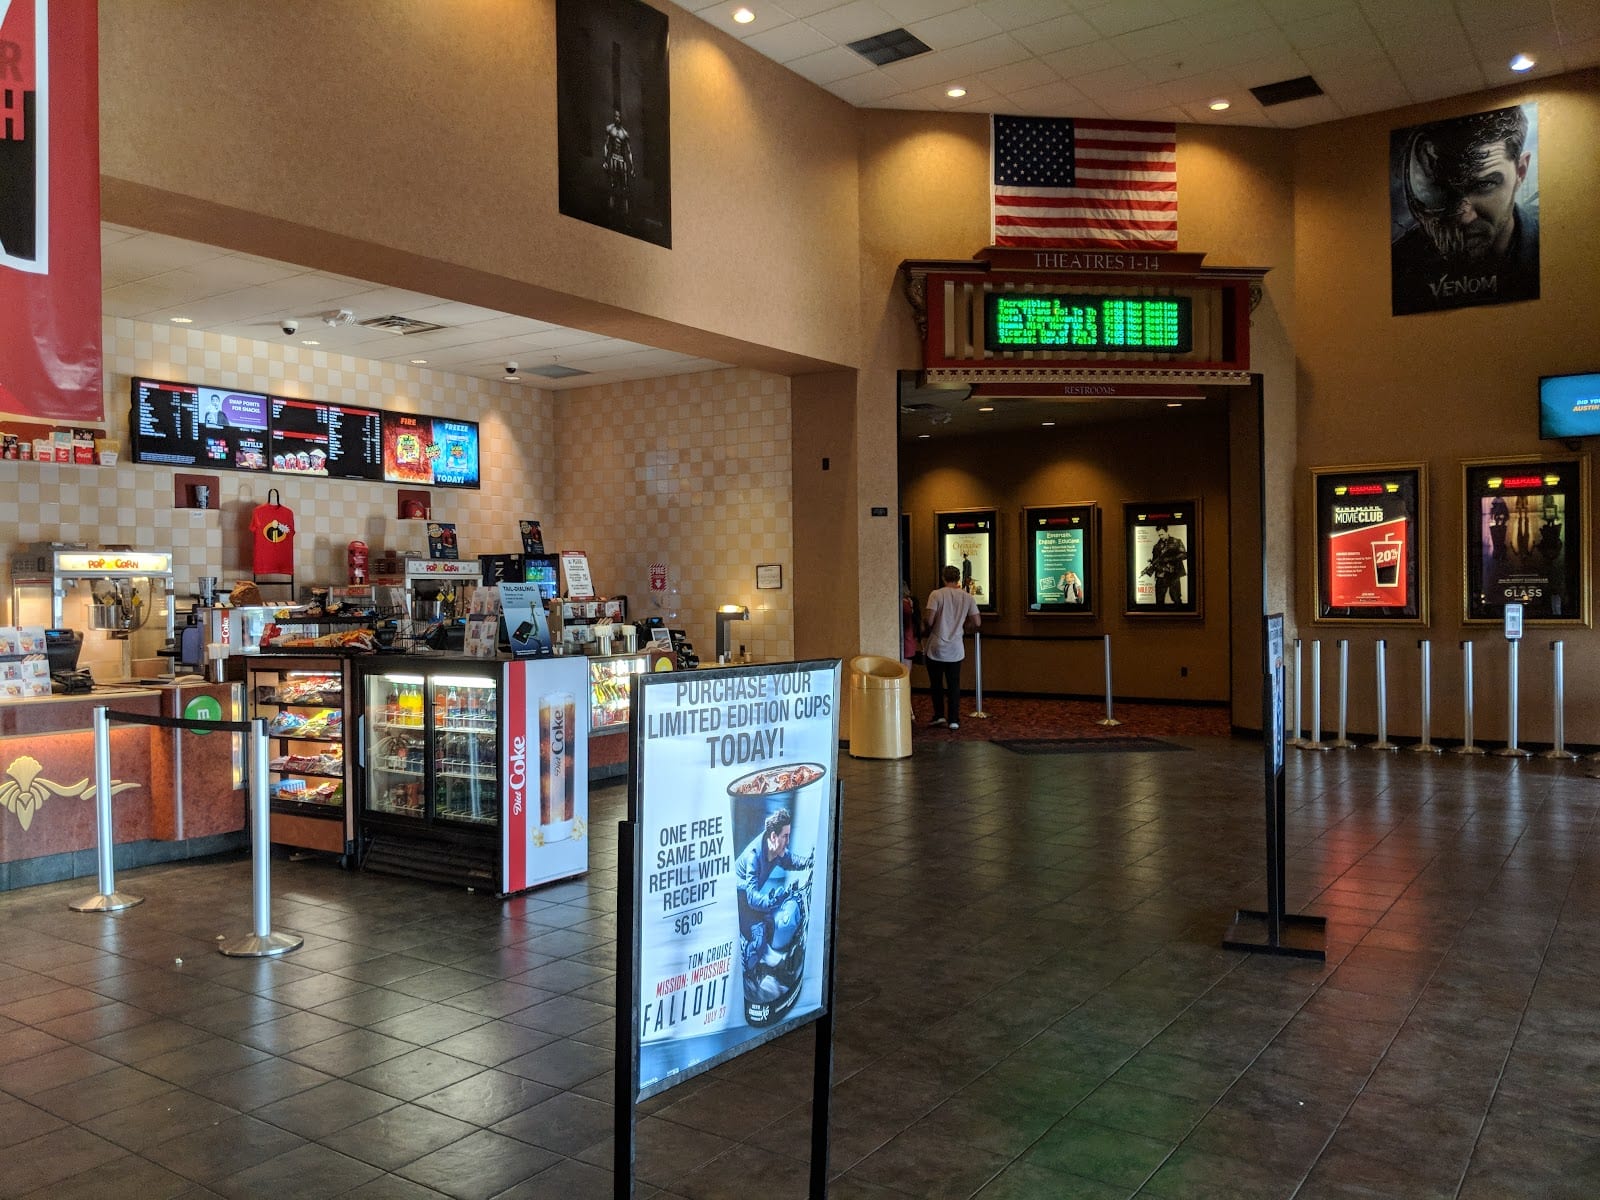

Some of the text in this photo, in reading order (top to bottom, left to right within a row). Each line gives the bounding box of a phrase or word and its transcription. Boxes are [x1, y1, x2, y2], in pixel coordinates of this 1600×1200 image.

[1034, 253, 1159, 270] THEATRES 1-14
[1428, 273, 1498, 298] VENOM
[999, 299, 1051, 308] Incredibles
[1054, 299, 1060, 308] 2
[999, 307, 1019, 315] Teen
[1023, 307, 1051, 315] Titans
[1072, 307, 1083, 315] To
[1085, 307, 1097, 315] Th
[999, 336, 1037, 344] Jurassic
[1072, 336, 1097, 344] Falle
[1040, 329, 1056, 337] Day
[1059, 329, 1069, 337] of
[1072, 329, 1088, 337] the
[1064, 386, 1116, 395] RESTROOMS
[243, 400, 260, 408] POINTS
[400, 417, 417, 426] FIRE
[444, 423, 469, 432] FREEZE
[239, 440, 264, 449] REFILLS
[437, 475, 465, 484] TODAY!
[88, 559, 105, 569] POP
[425, 563, 438, 572] POP
[652, 567, 665, 575] FIRE
[1504, 588, 1543, 598] GLASS
[675, 671, 811, 707] PURCHASE YOUR
[647, 694, 831, 740] LIMITED EDITION CUPS
[551, 709, 564, 754] Coke
[706, 727, 785, 769] TODAY!
[510, 736, 526, 791] Coke
[659, 816, 723, 848] ONE FREE
[656, 836, 725, 870] SAME DAY
[649, 855, 731, 894] REFILL WITH
[663, 880, 717, 912] RECEIPT
[688, 941, 733, 968] TOM CRUISE
[656, 959, 731, 998] MISSION: IMPOSSIBLE
[643, 975, 730, 1037] FALLOUT
[704, 1009, 718, 1026] JULY
